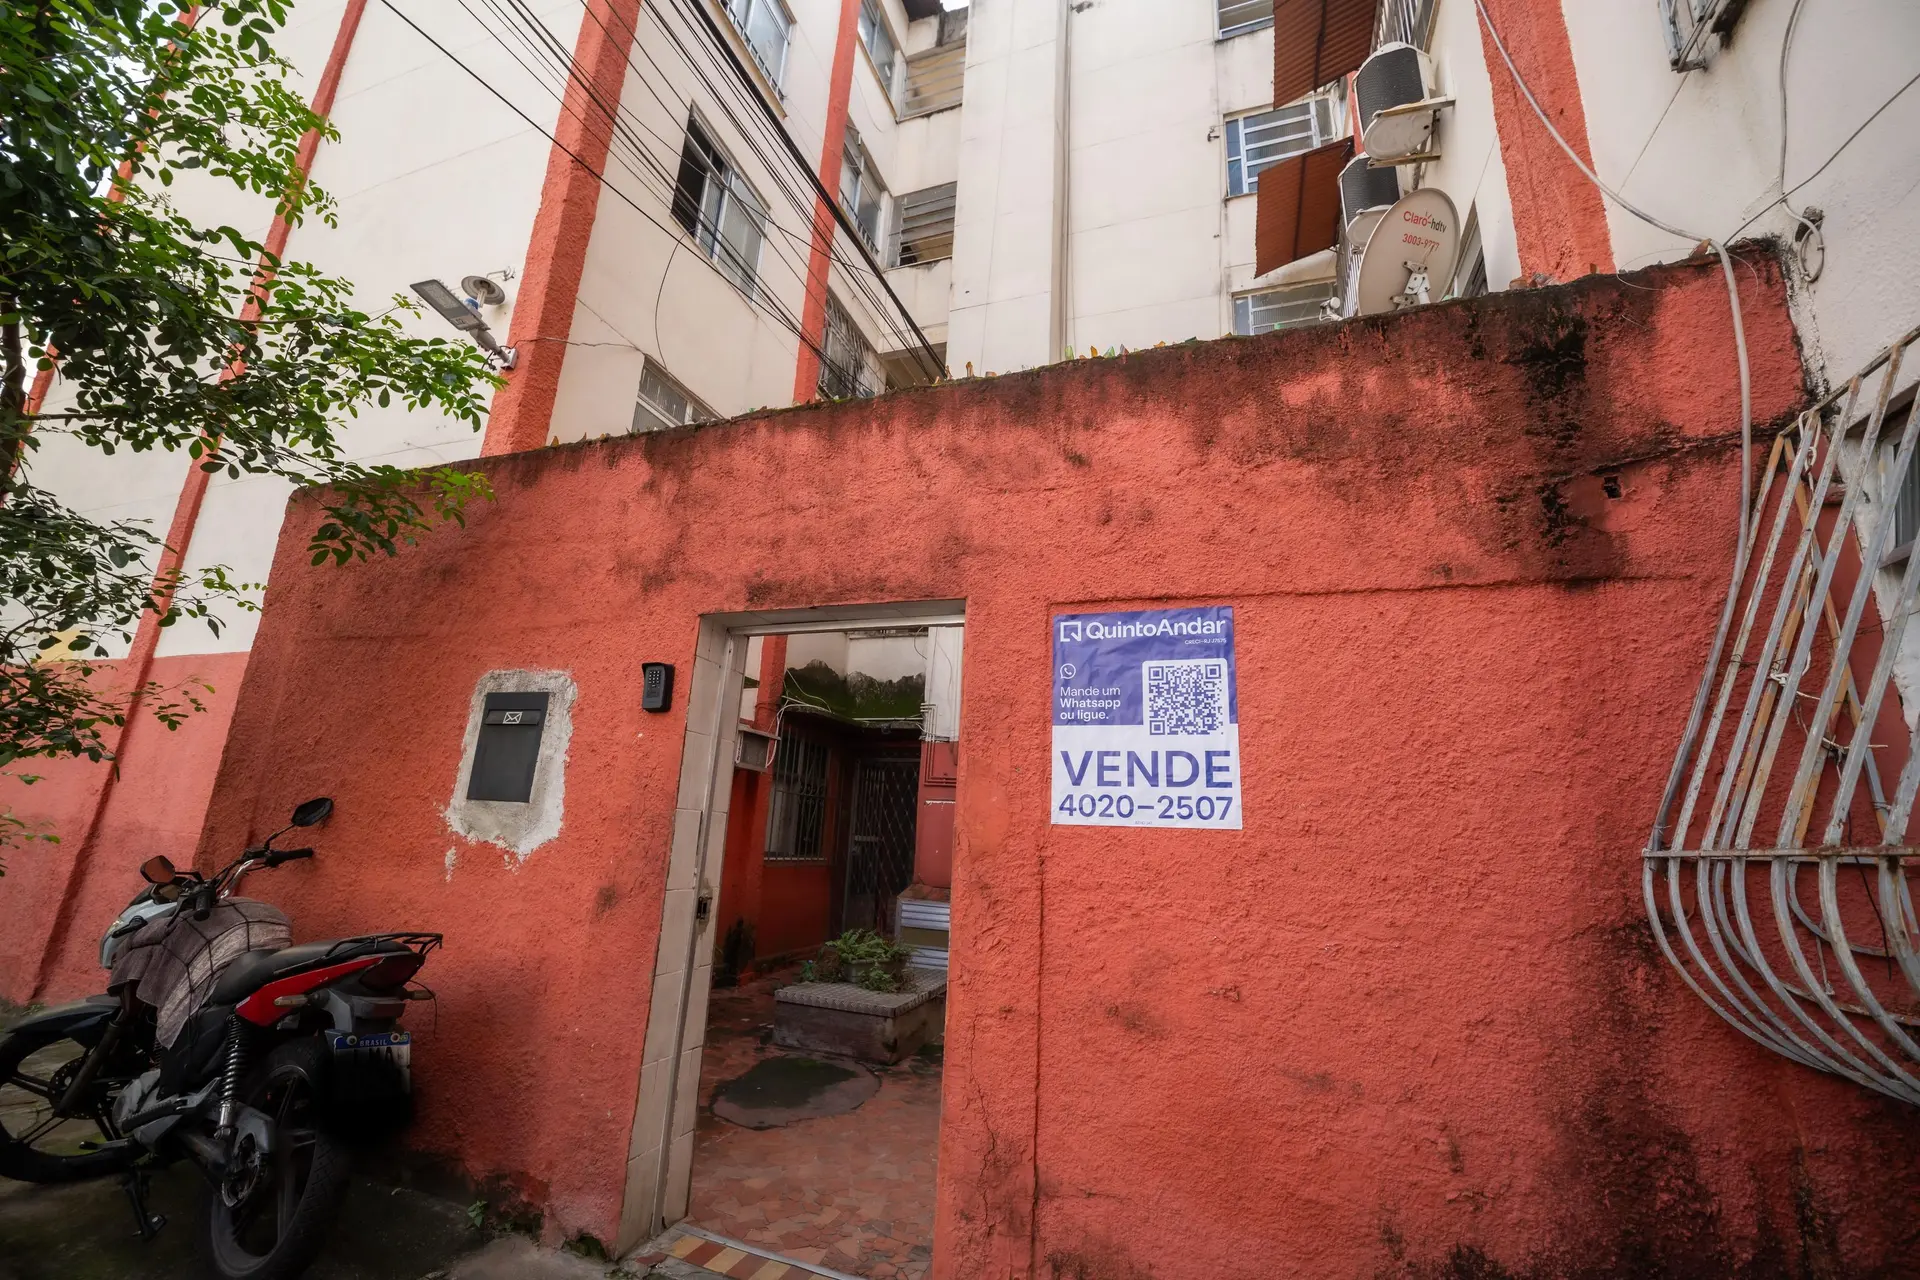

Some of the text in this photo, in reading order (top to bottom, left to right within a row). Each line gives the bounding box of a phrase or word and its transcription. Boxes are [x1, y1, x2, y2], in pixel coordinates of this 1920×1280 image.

[1085, 617, 1226, 640] QuintoAndar
[1060, 686, 1121, 697] Mande um
[1060, 698, 1121, 710] Whatsapp
[1060, 709, 1109, 722] ou ligue.
[1060, 750, 1233, 788] VENDE
[1058, 793, 1234, 821] 4020-2507
[360, 1039, 387, 1047] BRASIL
